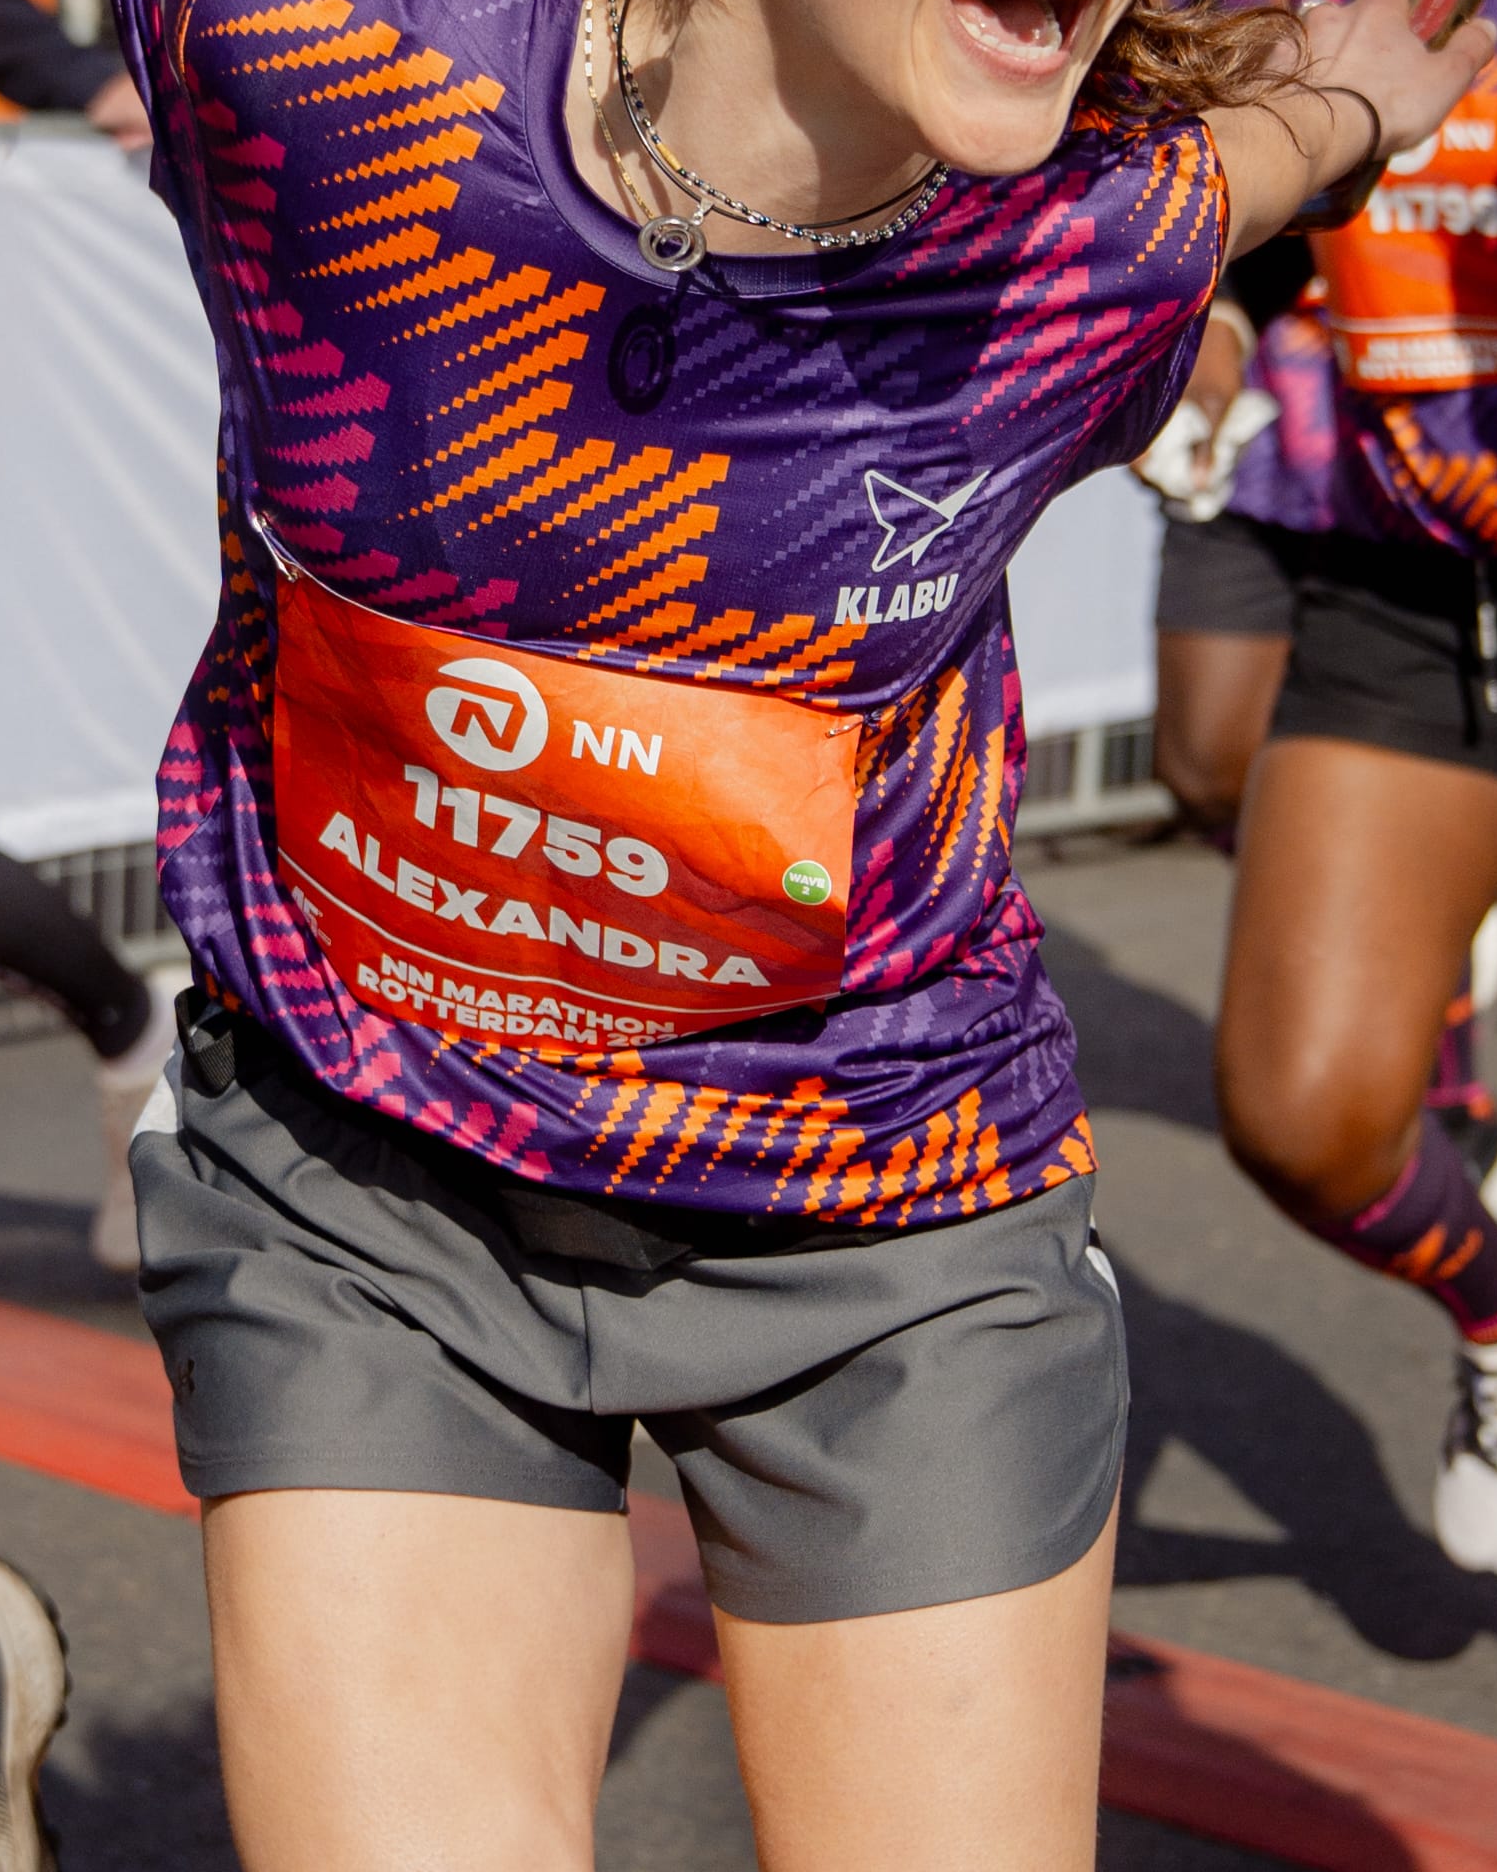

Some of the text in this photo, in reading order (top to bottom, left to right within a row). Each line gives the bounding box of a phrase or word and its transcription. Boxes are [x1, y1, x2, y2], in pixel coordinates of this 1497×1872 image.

[834, 573, 959, 625] KLABU
[572, 720, 663, 776] NN
[404, 763, 669, 897] 11759
[318, 812, 771, 987] ALEXANDRA
[789, 872, 825, 889] WAVE
[357, 963, 698, 1048] ROTTERDAM 202
[381, 953, 675, 1035] NN MARATHON
